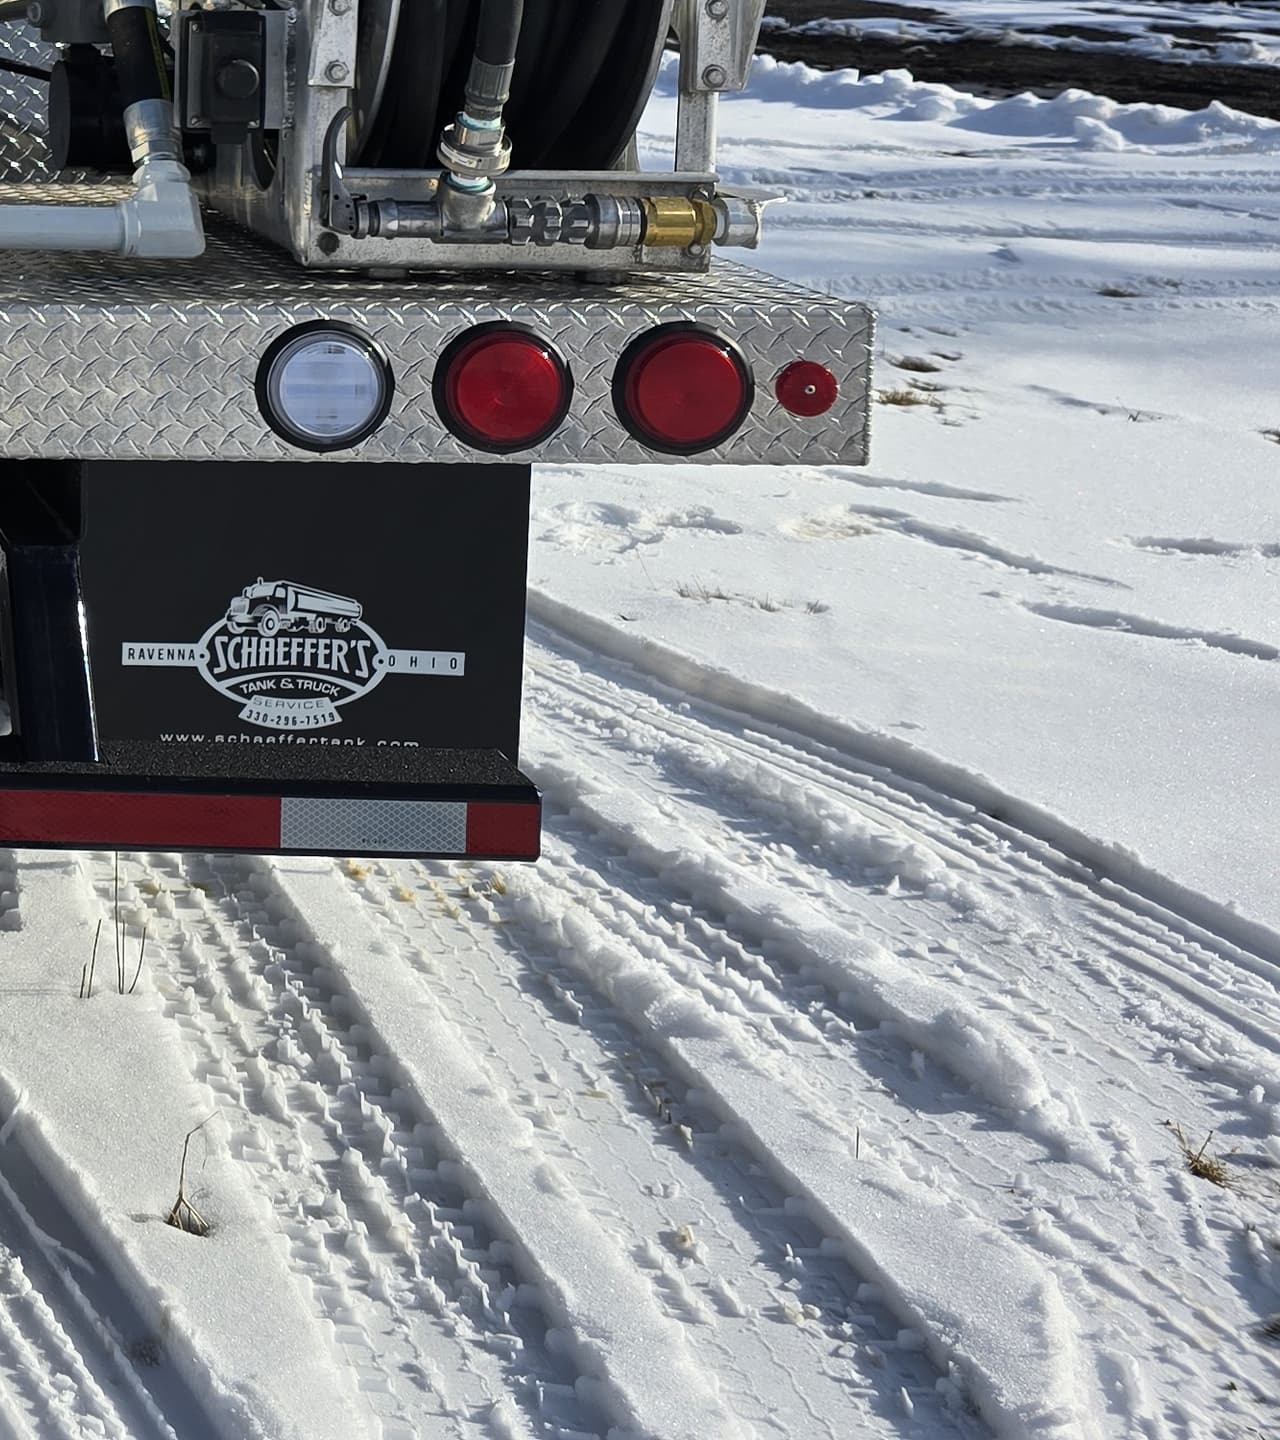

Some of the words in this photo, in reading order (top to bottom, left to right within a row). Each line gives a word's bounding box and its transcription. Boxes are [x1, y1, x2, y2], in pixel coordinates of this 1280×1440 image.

[127, 647, 196, 661] RAVENNA
[213, 635, 371, 678] SCHAEFFER'S
[387, 654, 458, 671] OHIO
[240, 679, 277, 695] TANK
[279, 677, 294, 689] &
[296, 679, 341, 697] TRUCK
[252, 695, 325, 709] SERVICE
[246, 709, 336, 726] 330-296-7519
